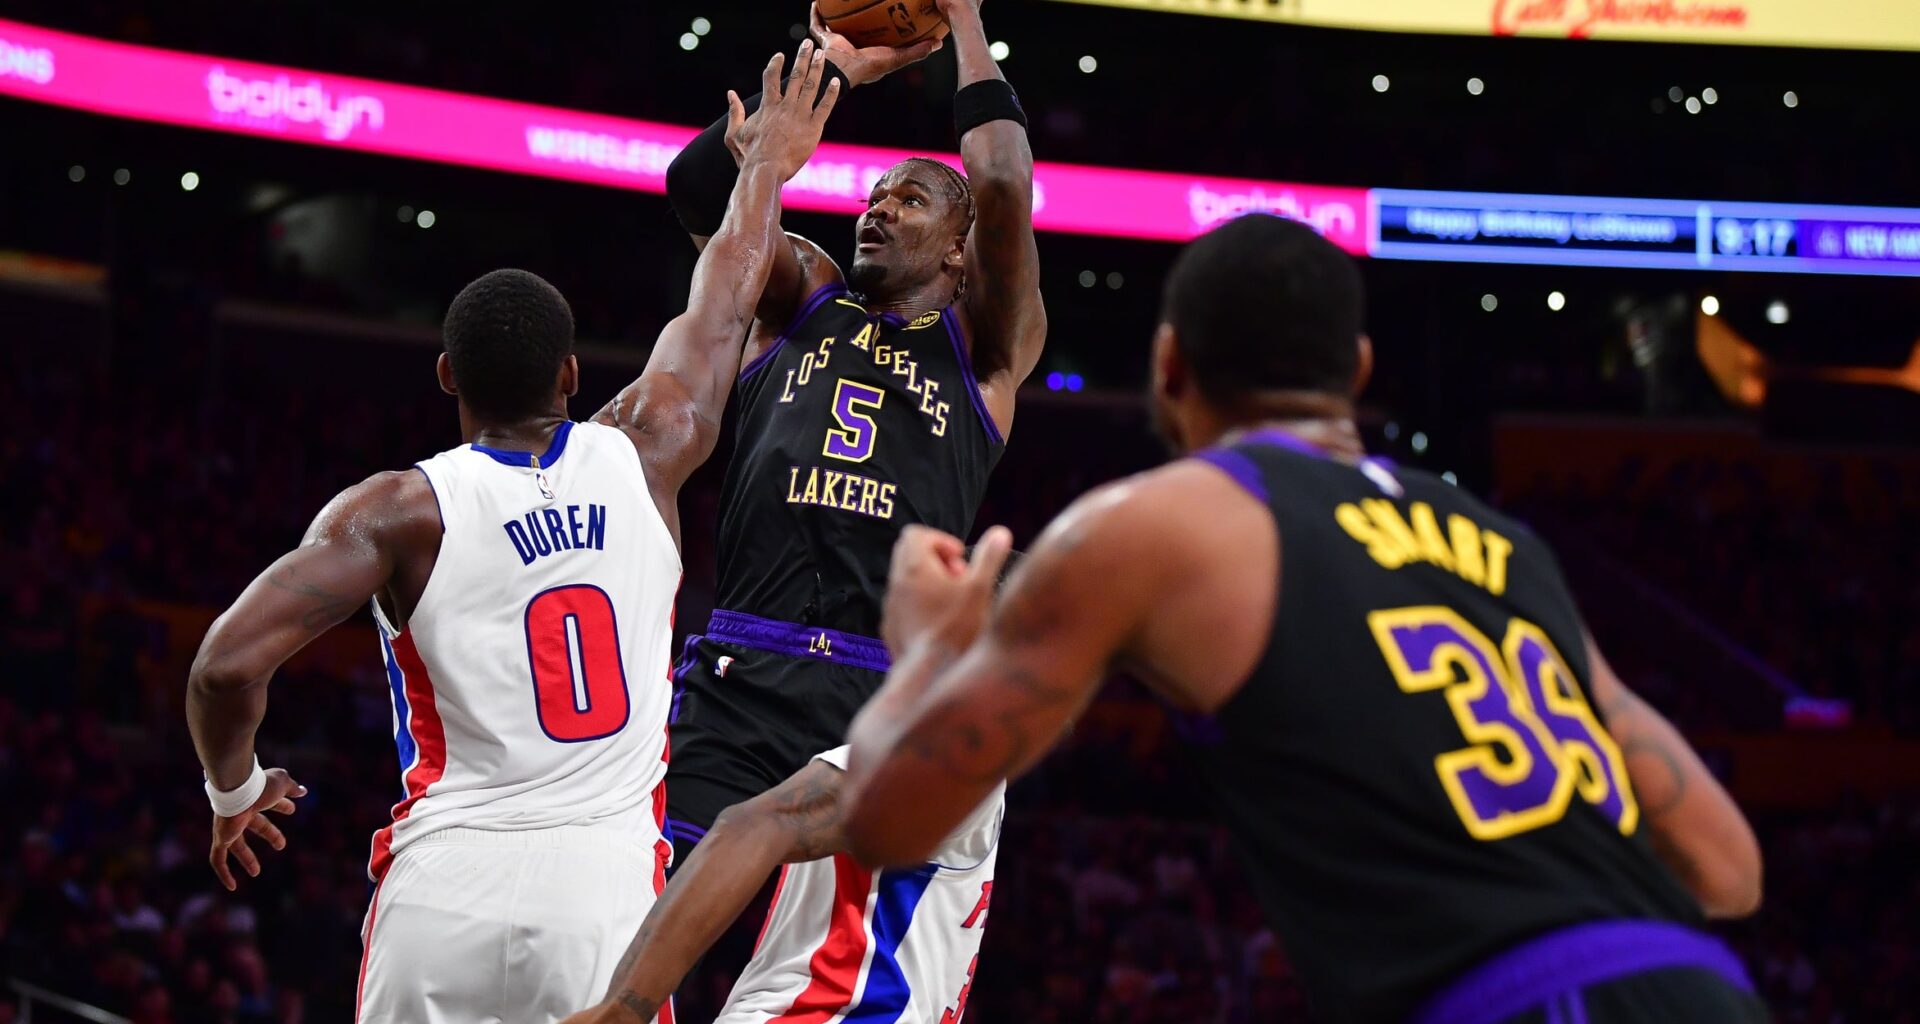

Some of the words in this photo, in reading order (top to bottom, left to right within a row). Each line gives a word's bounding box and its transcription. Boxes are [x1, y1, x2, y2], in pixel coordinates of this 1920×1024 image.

[207, 65, 385, 141] boldyn
[779, 337, 837, 403] LOS
[850, 322, 950, 438] AGELES
[822, 378, 886, 463] 5
[503, 503, 607, 567] DUREN
[786, 466, 897, 519] LAKERS
[1334, 497, 1514, 596] SMART
[524, 583, 631, 744] 0
[808, 632, 833, 657] LAL
[1366, 605, 1640, 842] 36
